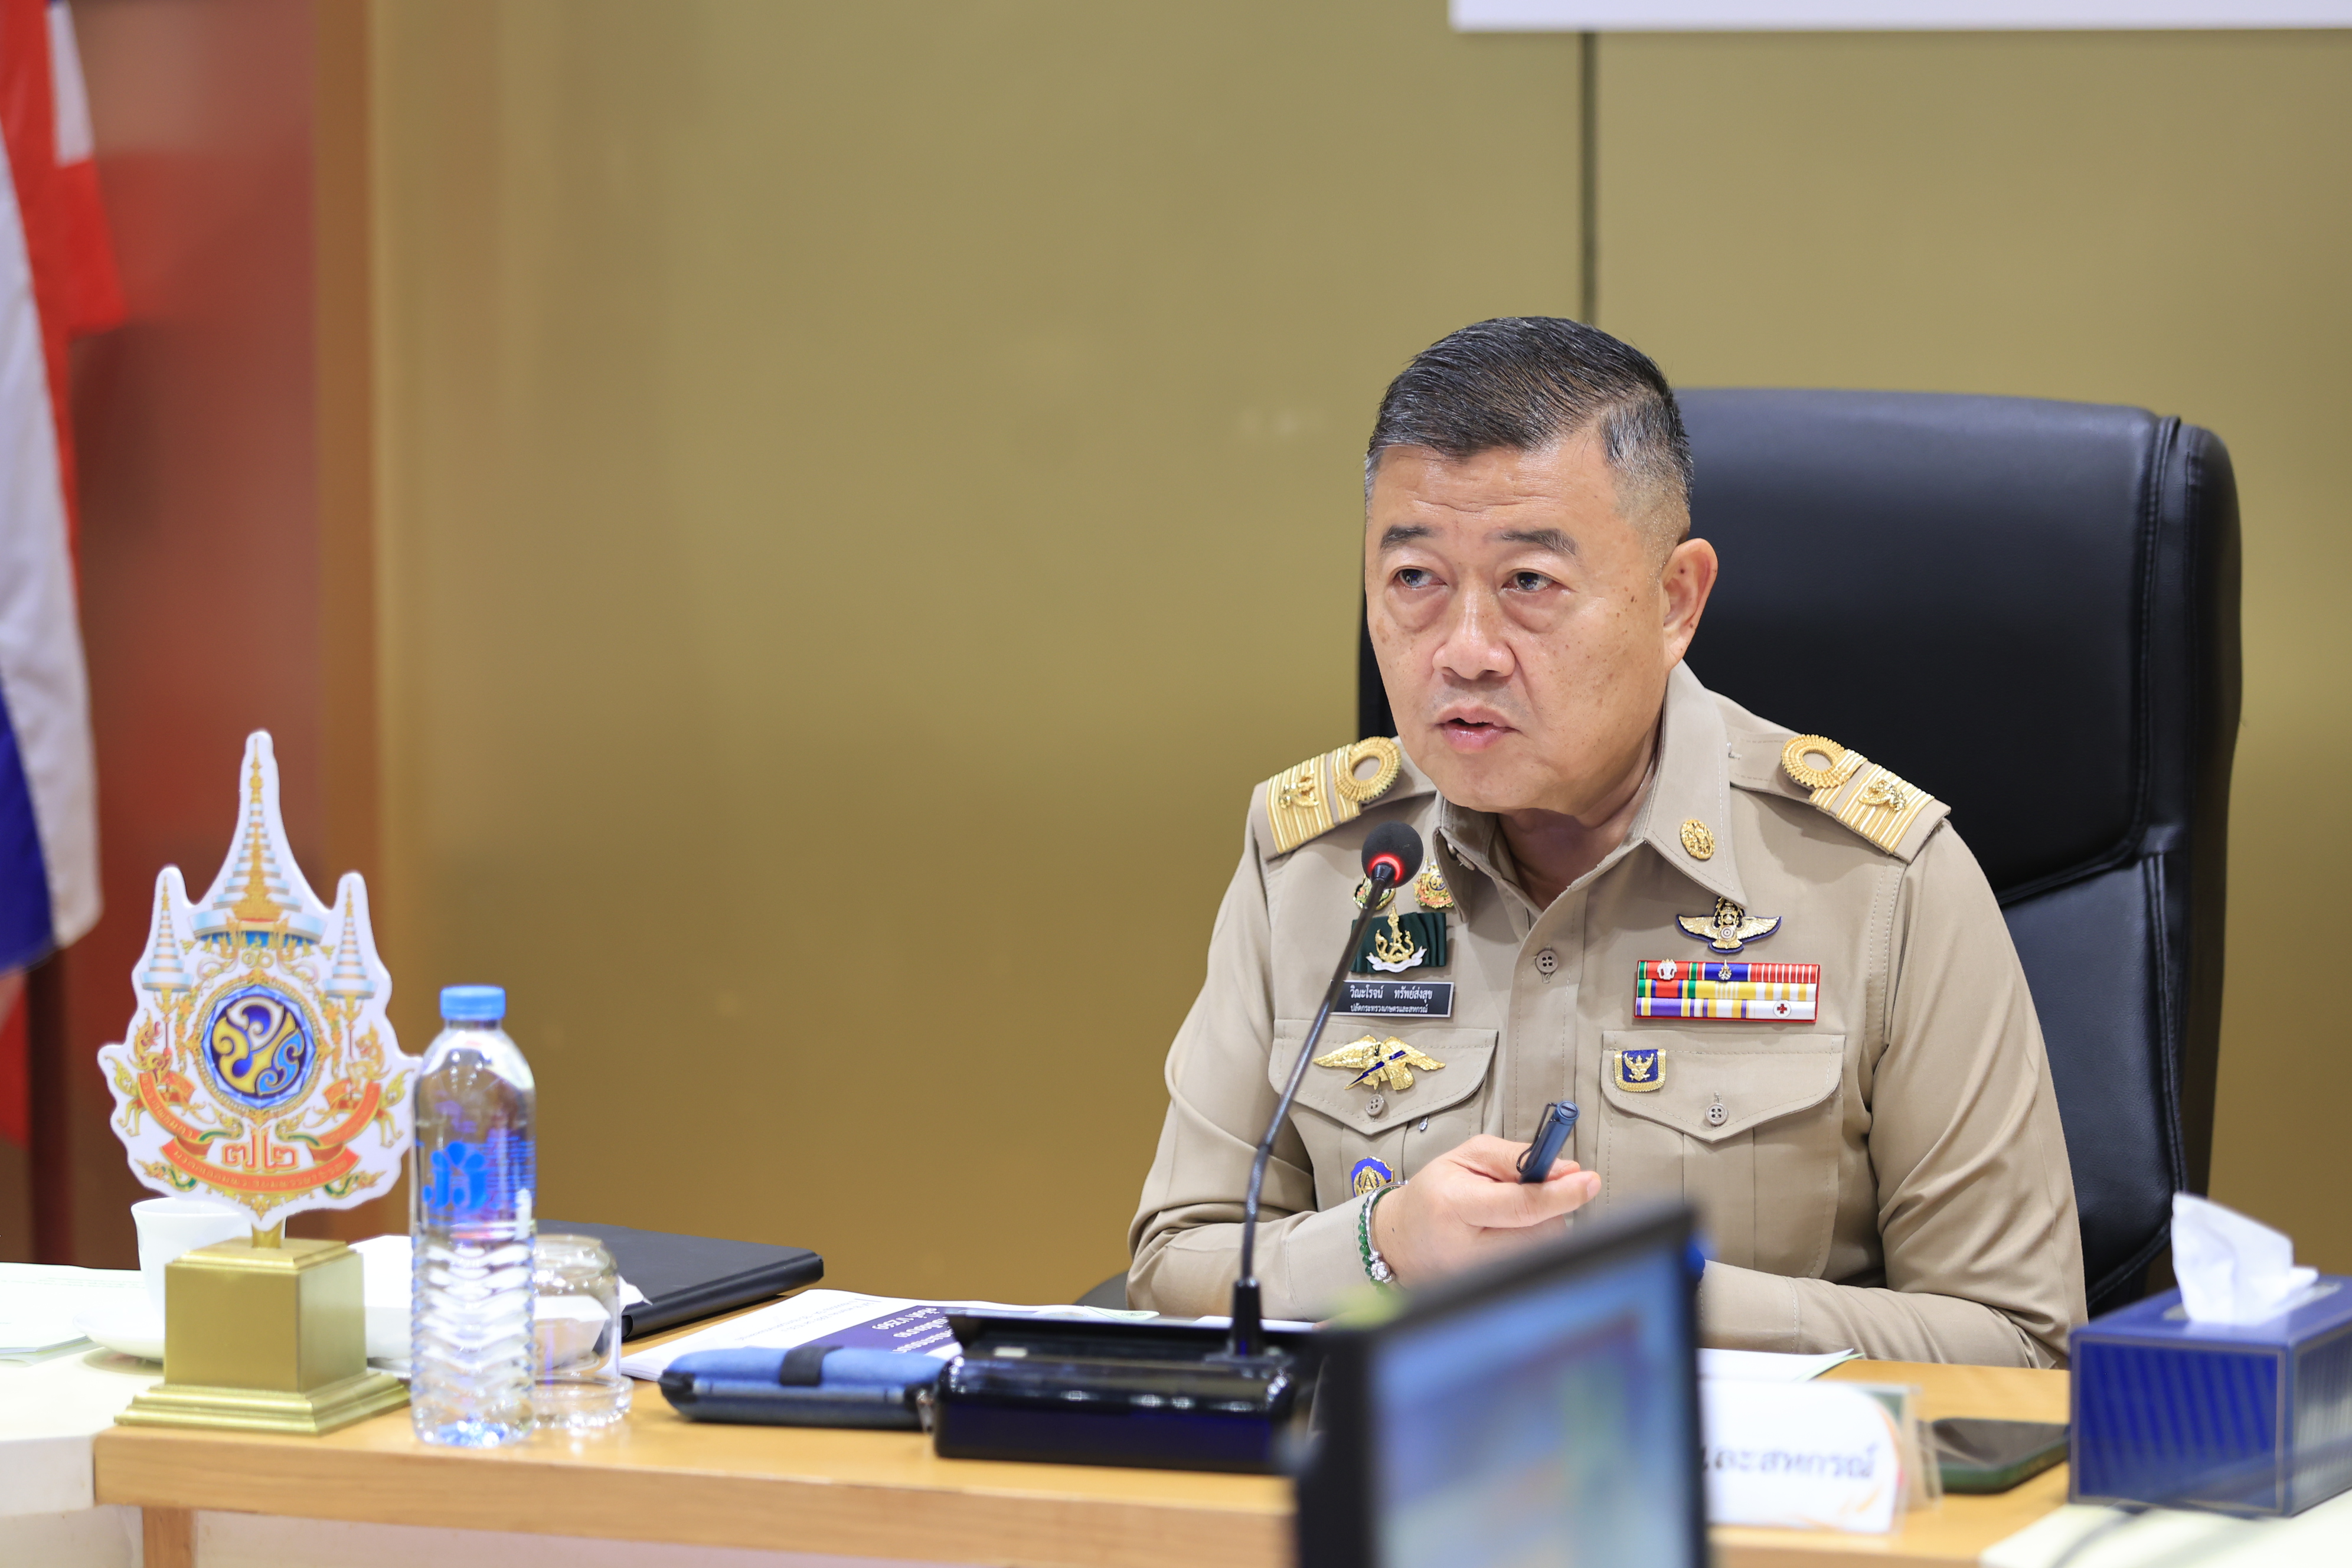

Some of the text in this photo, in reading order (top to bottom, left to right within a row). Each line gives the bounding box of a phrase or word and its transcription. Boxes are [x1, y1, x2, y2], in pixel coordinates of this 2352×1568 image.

[1350, 984, 1433, 1004] วิณะโรจน์ ทรัพย์ส่งสุข
[872, 1317, 914, 1330] 1/2569
[1701, 1441, 1879, 1478] ละสหกรณ์
